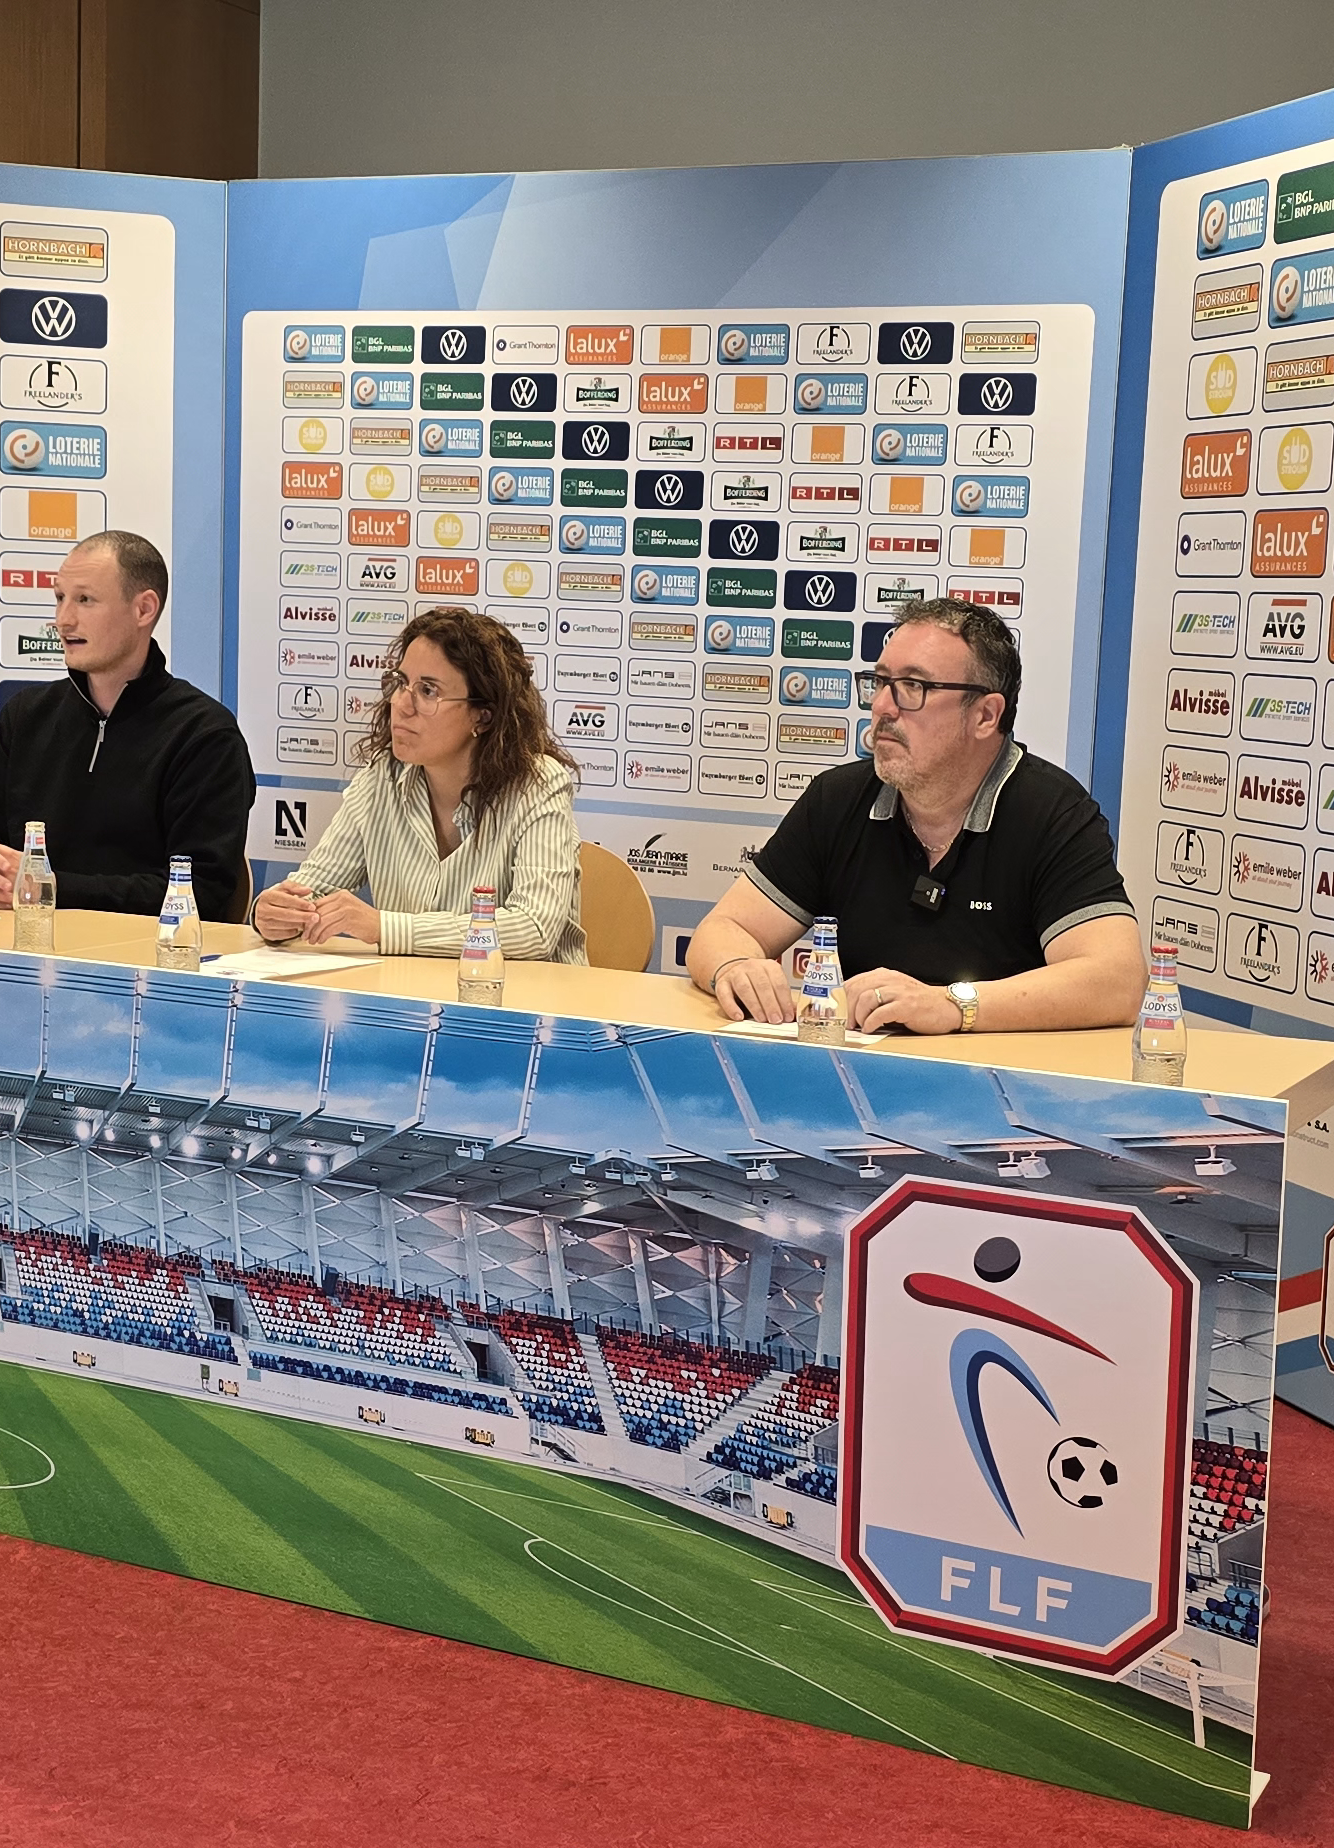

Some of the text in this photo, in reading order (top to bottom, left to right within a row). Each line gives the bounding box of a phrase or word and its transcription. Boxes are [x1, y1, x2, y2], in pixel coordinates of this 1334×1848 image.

[8, 239, 87, 256] HORNBACH
[1198, 288, 1247, 308] HORNBACH
[312, 333, 341, 346] LOTERIE
[369, 337, 383, 345] BGL
[570, 332, 616, 353] lalux
[967, 335, 1024, 345] HORNBACH
[312, 345, 341, 356] NATIONALE
[660, 353, 688, 362] orange
[579, 390, 615, 400] BOFFERDING
[986, 486, 1025, 500] LOTERIE
[986, 499, 1025, 509] NATIONALE
[361, 565, 396, 580] AVG
[284, 607, 336, 622] Alvisse
[1198, 615, 1235, 628] 3S-TECH
[1170, 689, 1230, 716] Alvisse
[275, 839, 306, 847] NIESSEN
[1170, 862, 1207, 878] FREELANDER'S
[1144, 1000, 1177, 1014] LODYSS
[940, 1556, 1072, 1623] FLF
